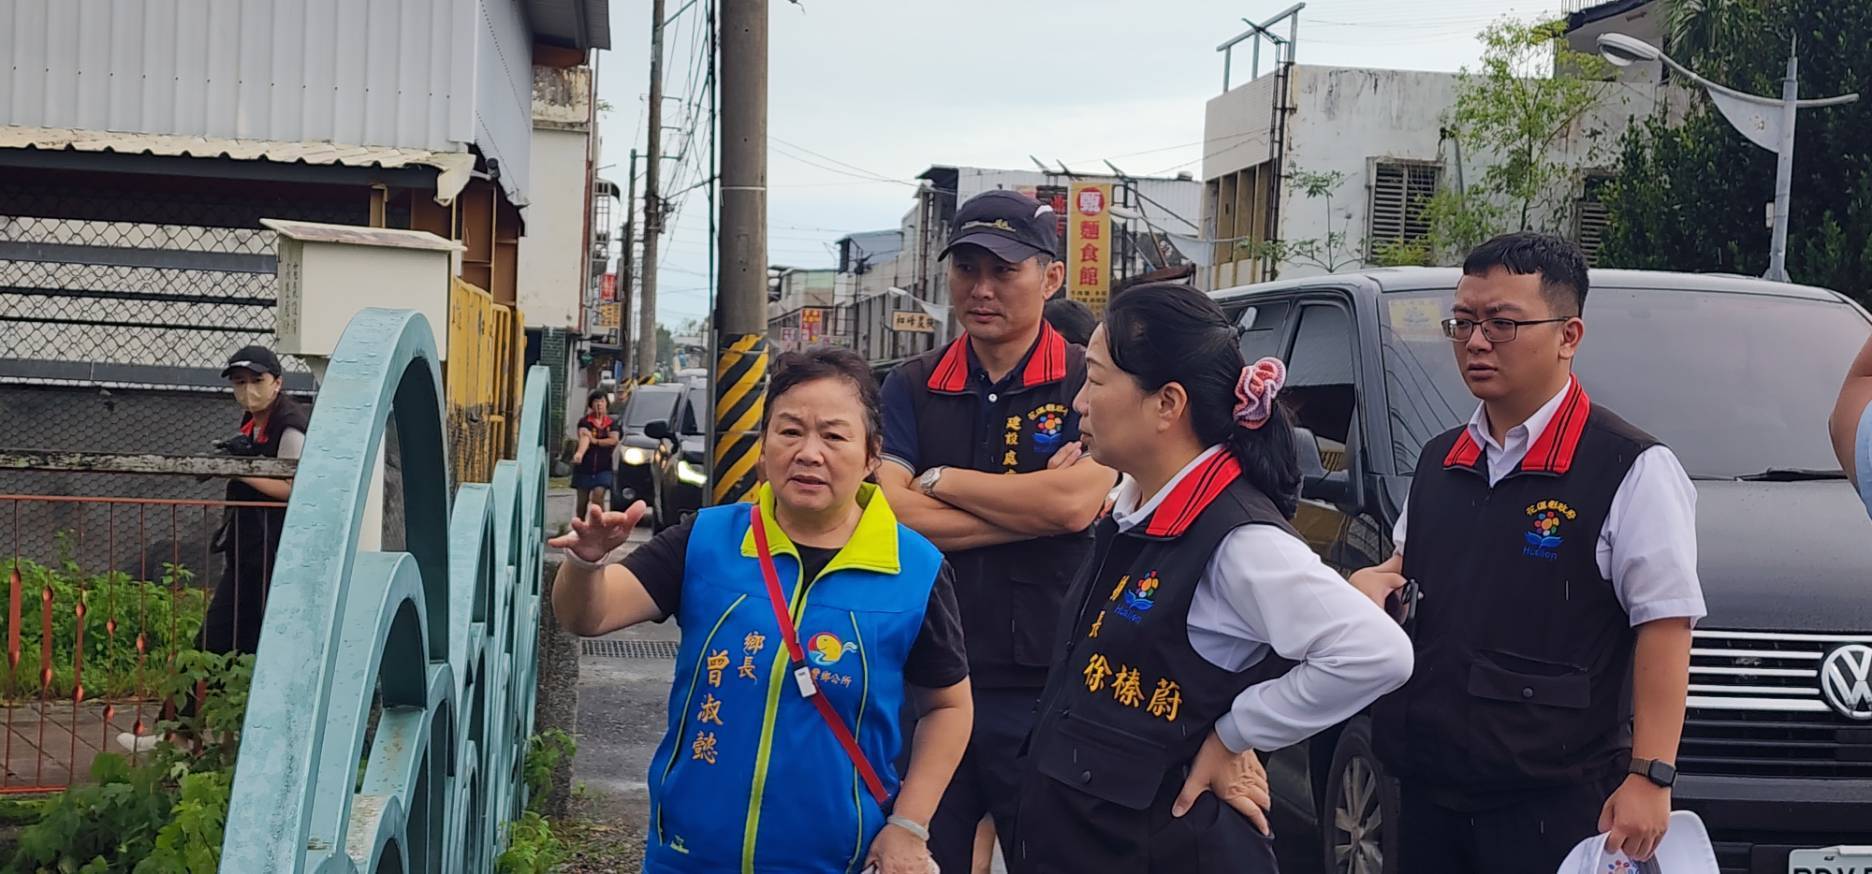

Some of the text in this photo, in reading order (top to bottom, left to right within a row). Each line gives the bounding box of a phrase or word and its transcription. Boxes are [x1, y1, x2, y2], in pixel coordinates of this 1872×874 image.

[737, 631, 766, 685] 鄉長
[1083, 653, 1183, 722] 徐榛蔚
